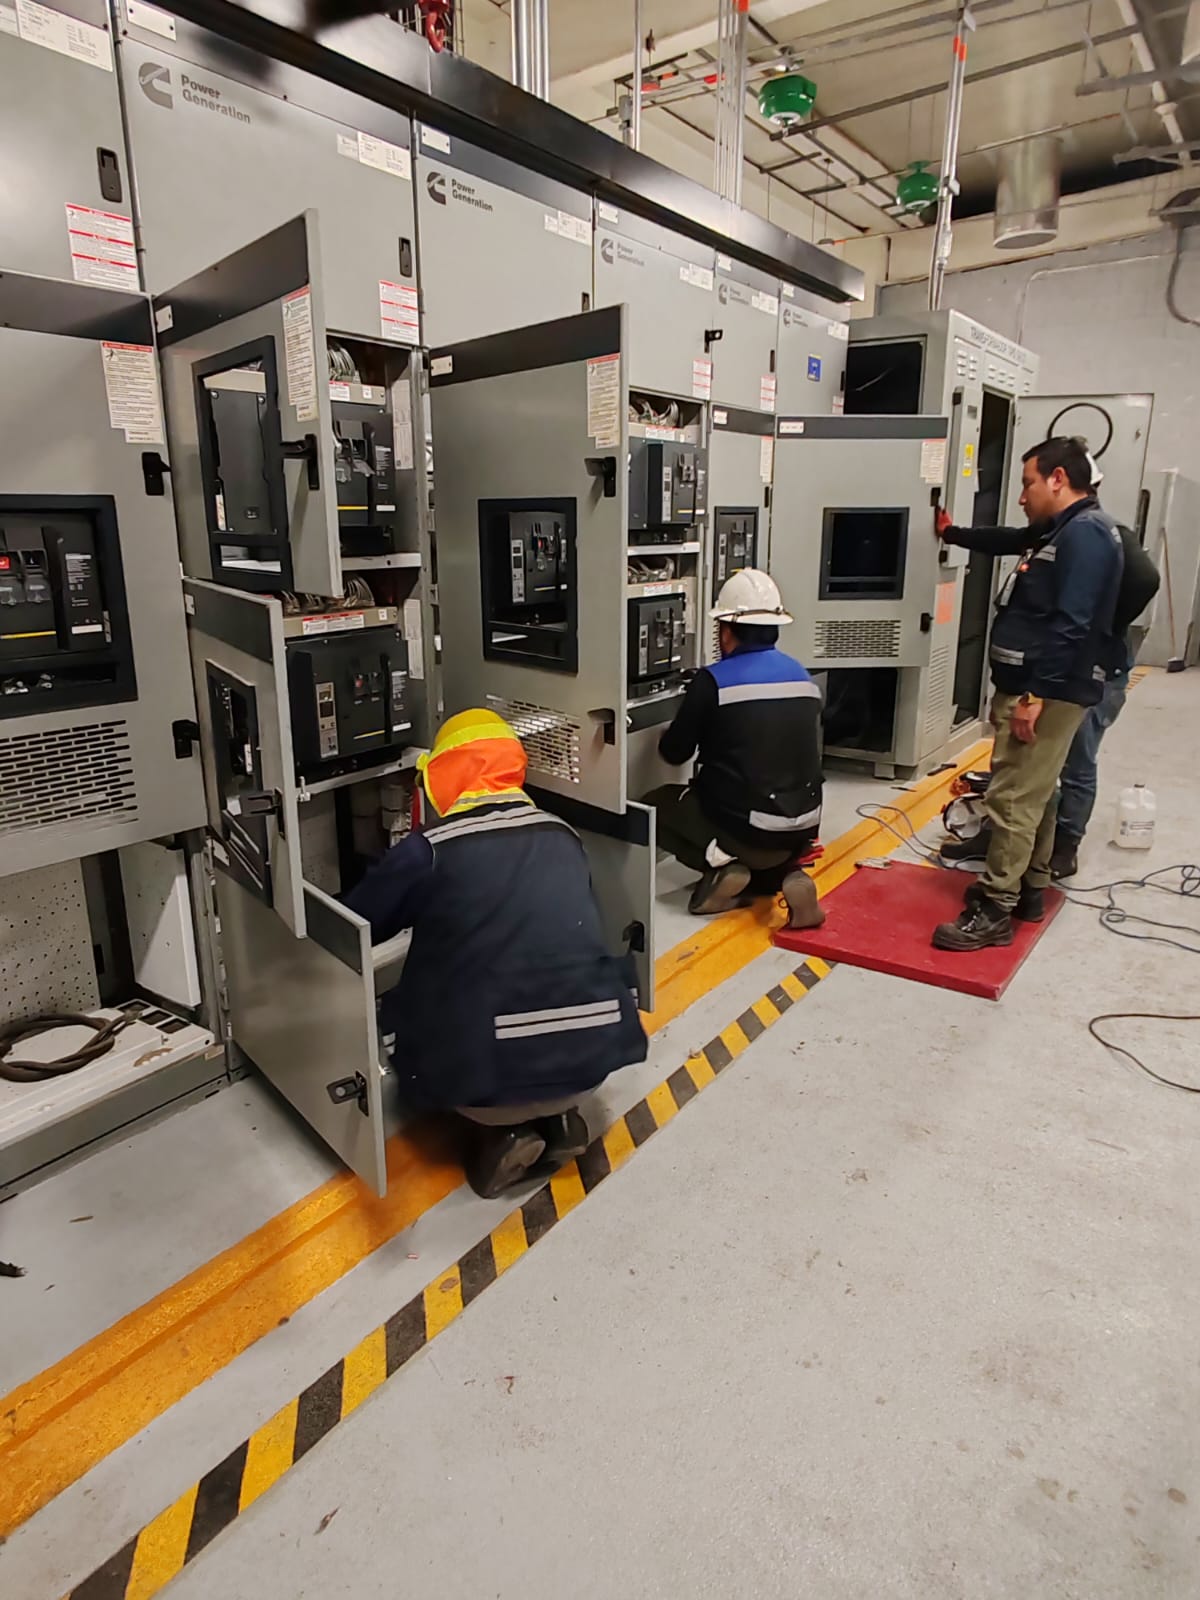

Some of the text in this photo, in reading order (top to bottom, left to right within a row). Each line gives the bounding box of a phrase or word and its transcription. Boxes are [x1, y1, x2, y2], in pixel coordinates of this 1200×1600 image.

[181, 74, 221, 99] Power
[182, 89, 251, 123] Generation
[451, 178, 475, 195] Power
[452, 189, 493, 212] Generation
